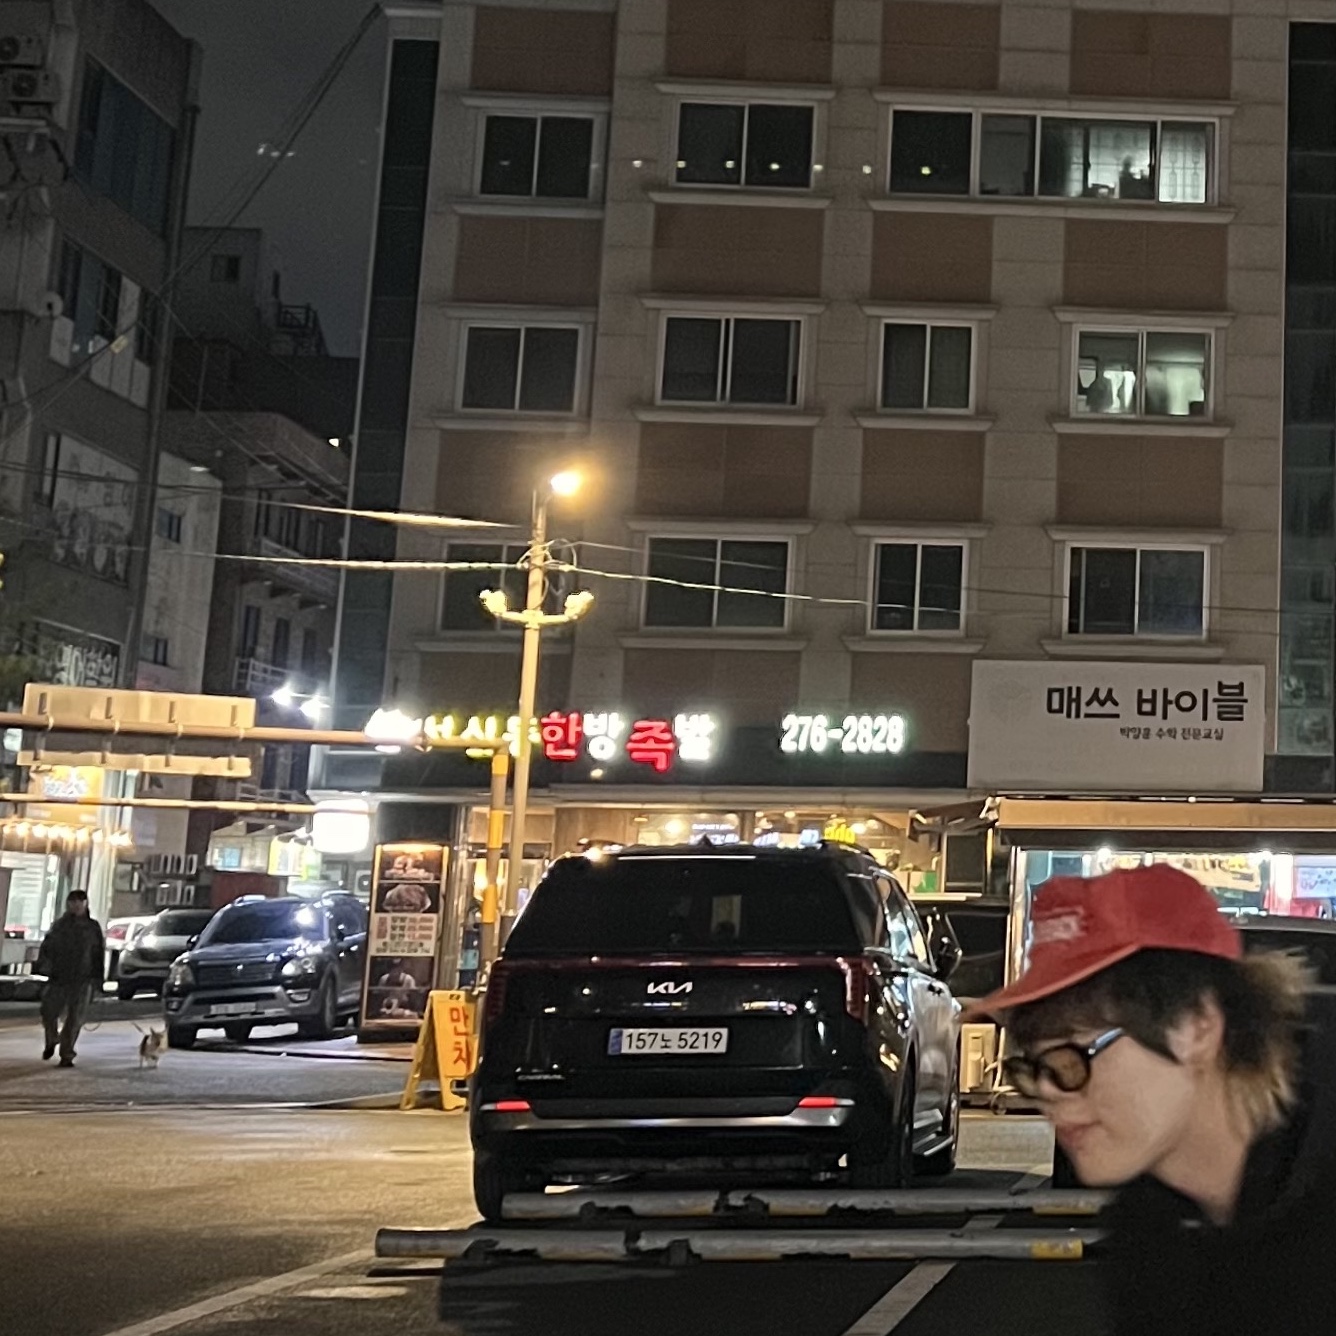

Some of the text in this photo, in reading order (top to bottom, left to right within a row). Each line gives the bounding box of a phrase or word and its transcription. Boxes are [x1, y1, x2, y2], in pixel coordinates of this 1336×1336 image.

[1046, 680, 1248, 721] 매쓰 바이블
[540, 710, 717, 772] 한방족발
[781, 713, 904, 754] 276-2828
[1155, 727, 1177, 740] 수학
[626, 1031, 724, 1050] 157노 5219
